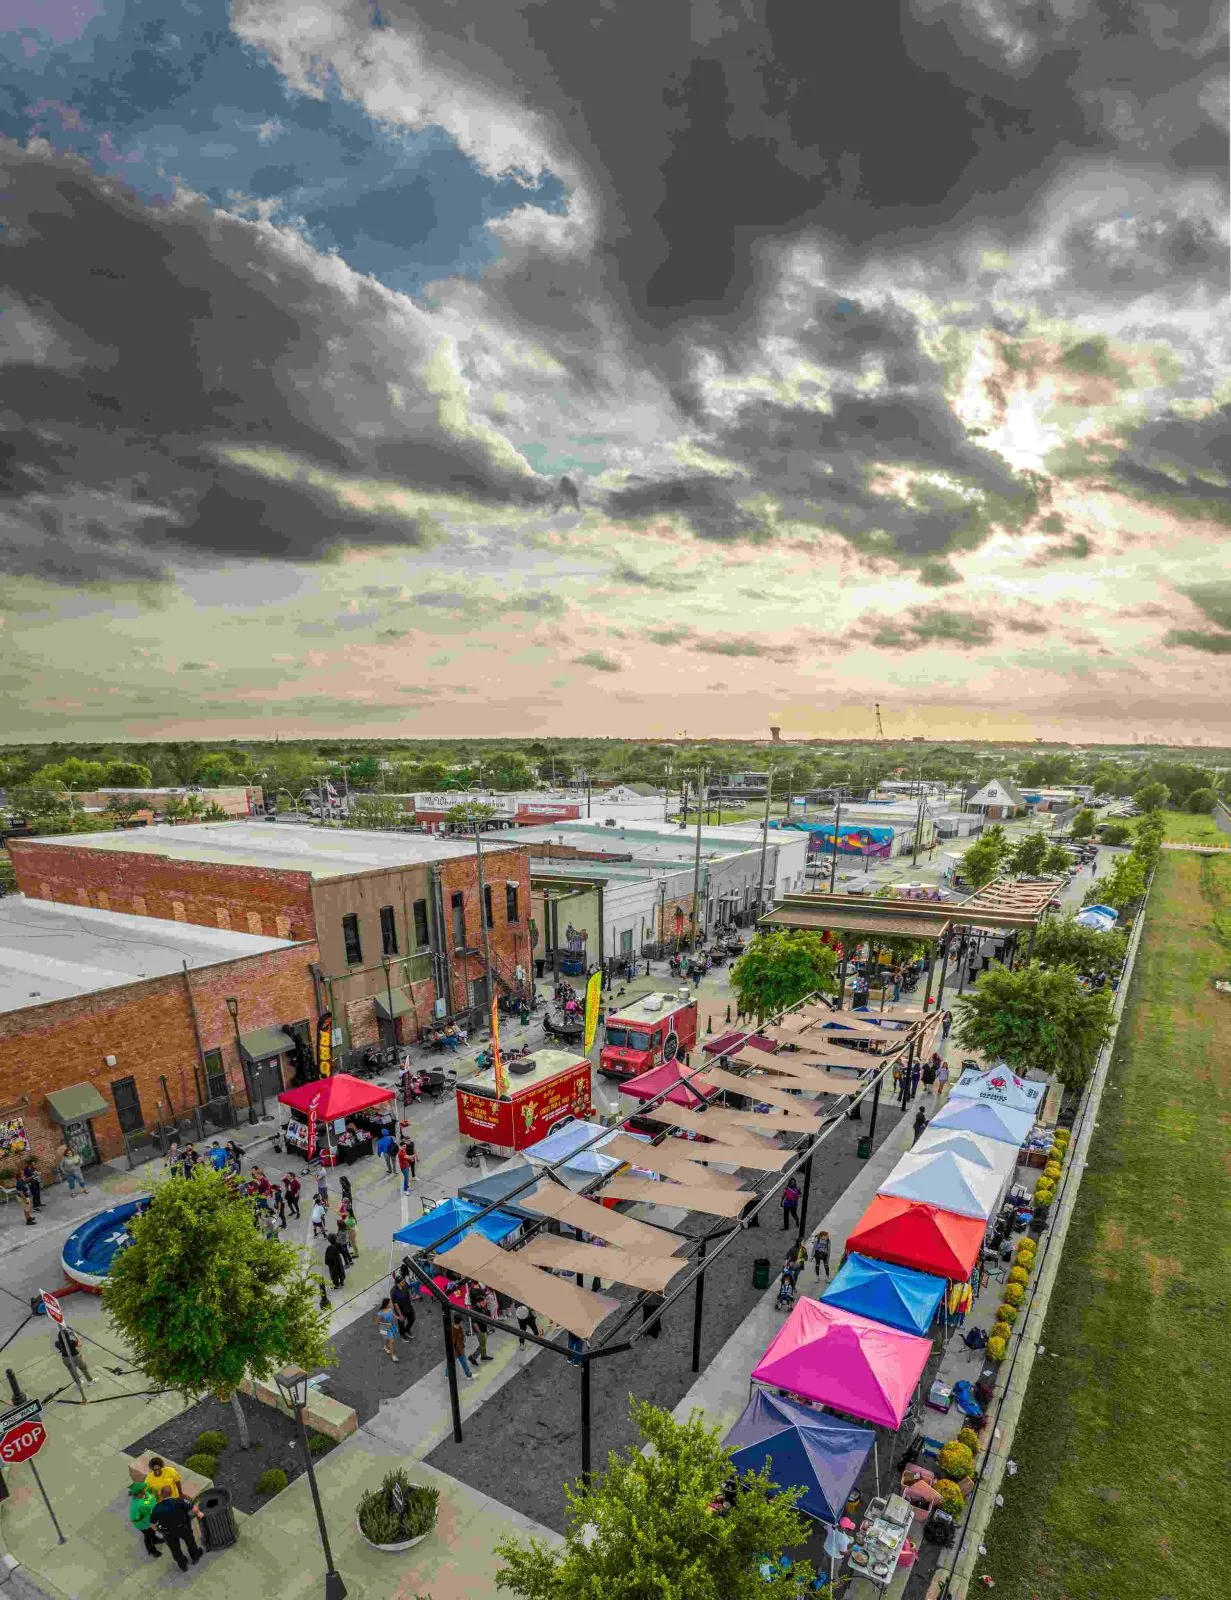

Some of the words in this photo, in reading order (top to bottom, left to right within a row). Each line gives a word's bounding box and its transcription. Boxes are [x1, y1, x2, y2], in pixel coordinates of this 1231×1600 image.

[2, 1415, 19, 1427] ONE
[20, 1404, 36, 1417] WAY
[3, 1427, 42, 1458] STOP
